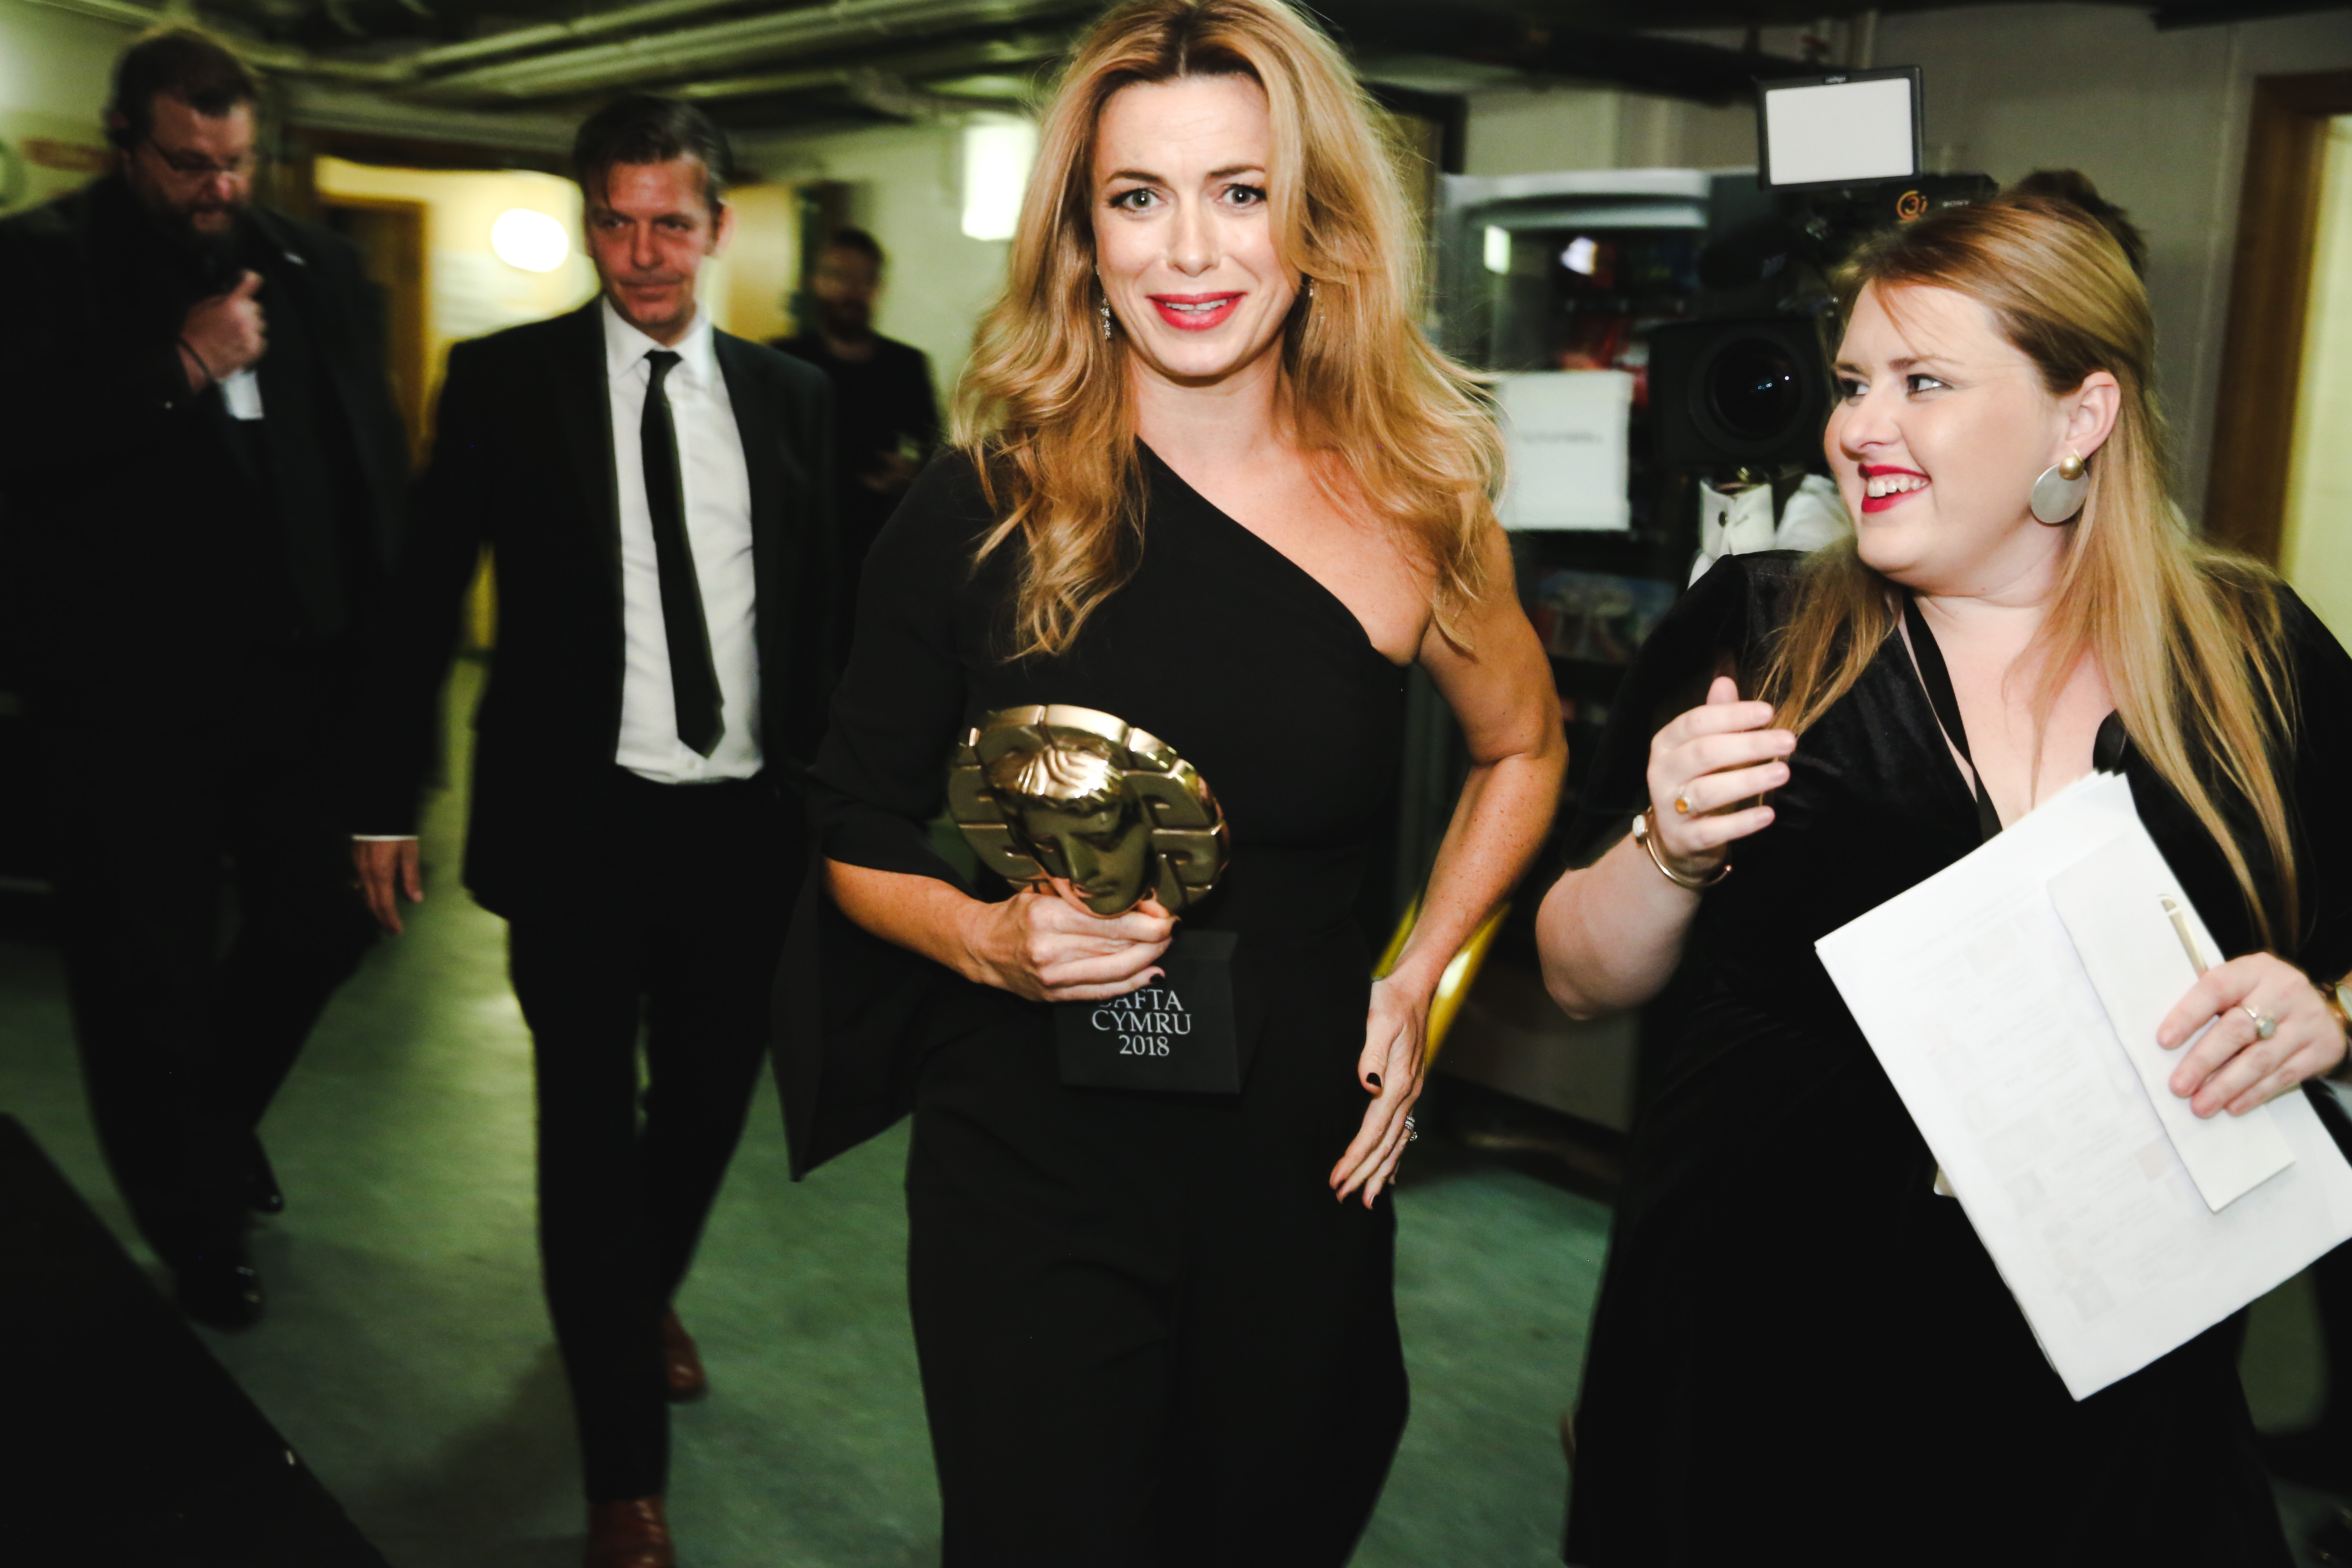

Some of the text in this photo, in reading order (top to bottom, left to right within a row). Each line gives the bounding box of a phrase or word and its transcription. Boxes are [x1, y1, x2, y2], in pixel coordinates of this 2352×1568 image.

[1099, 989, 1184, 1011] AFTA
[1092, 1009, 1192, 1034] CYMRU
[1118, 1034, 1170, 1056] 2018
